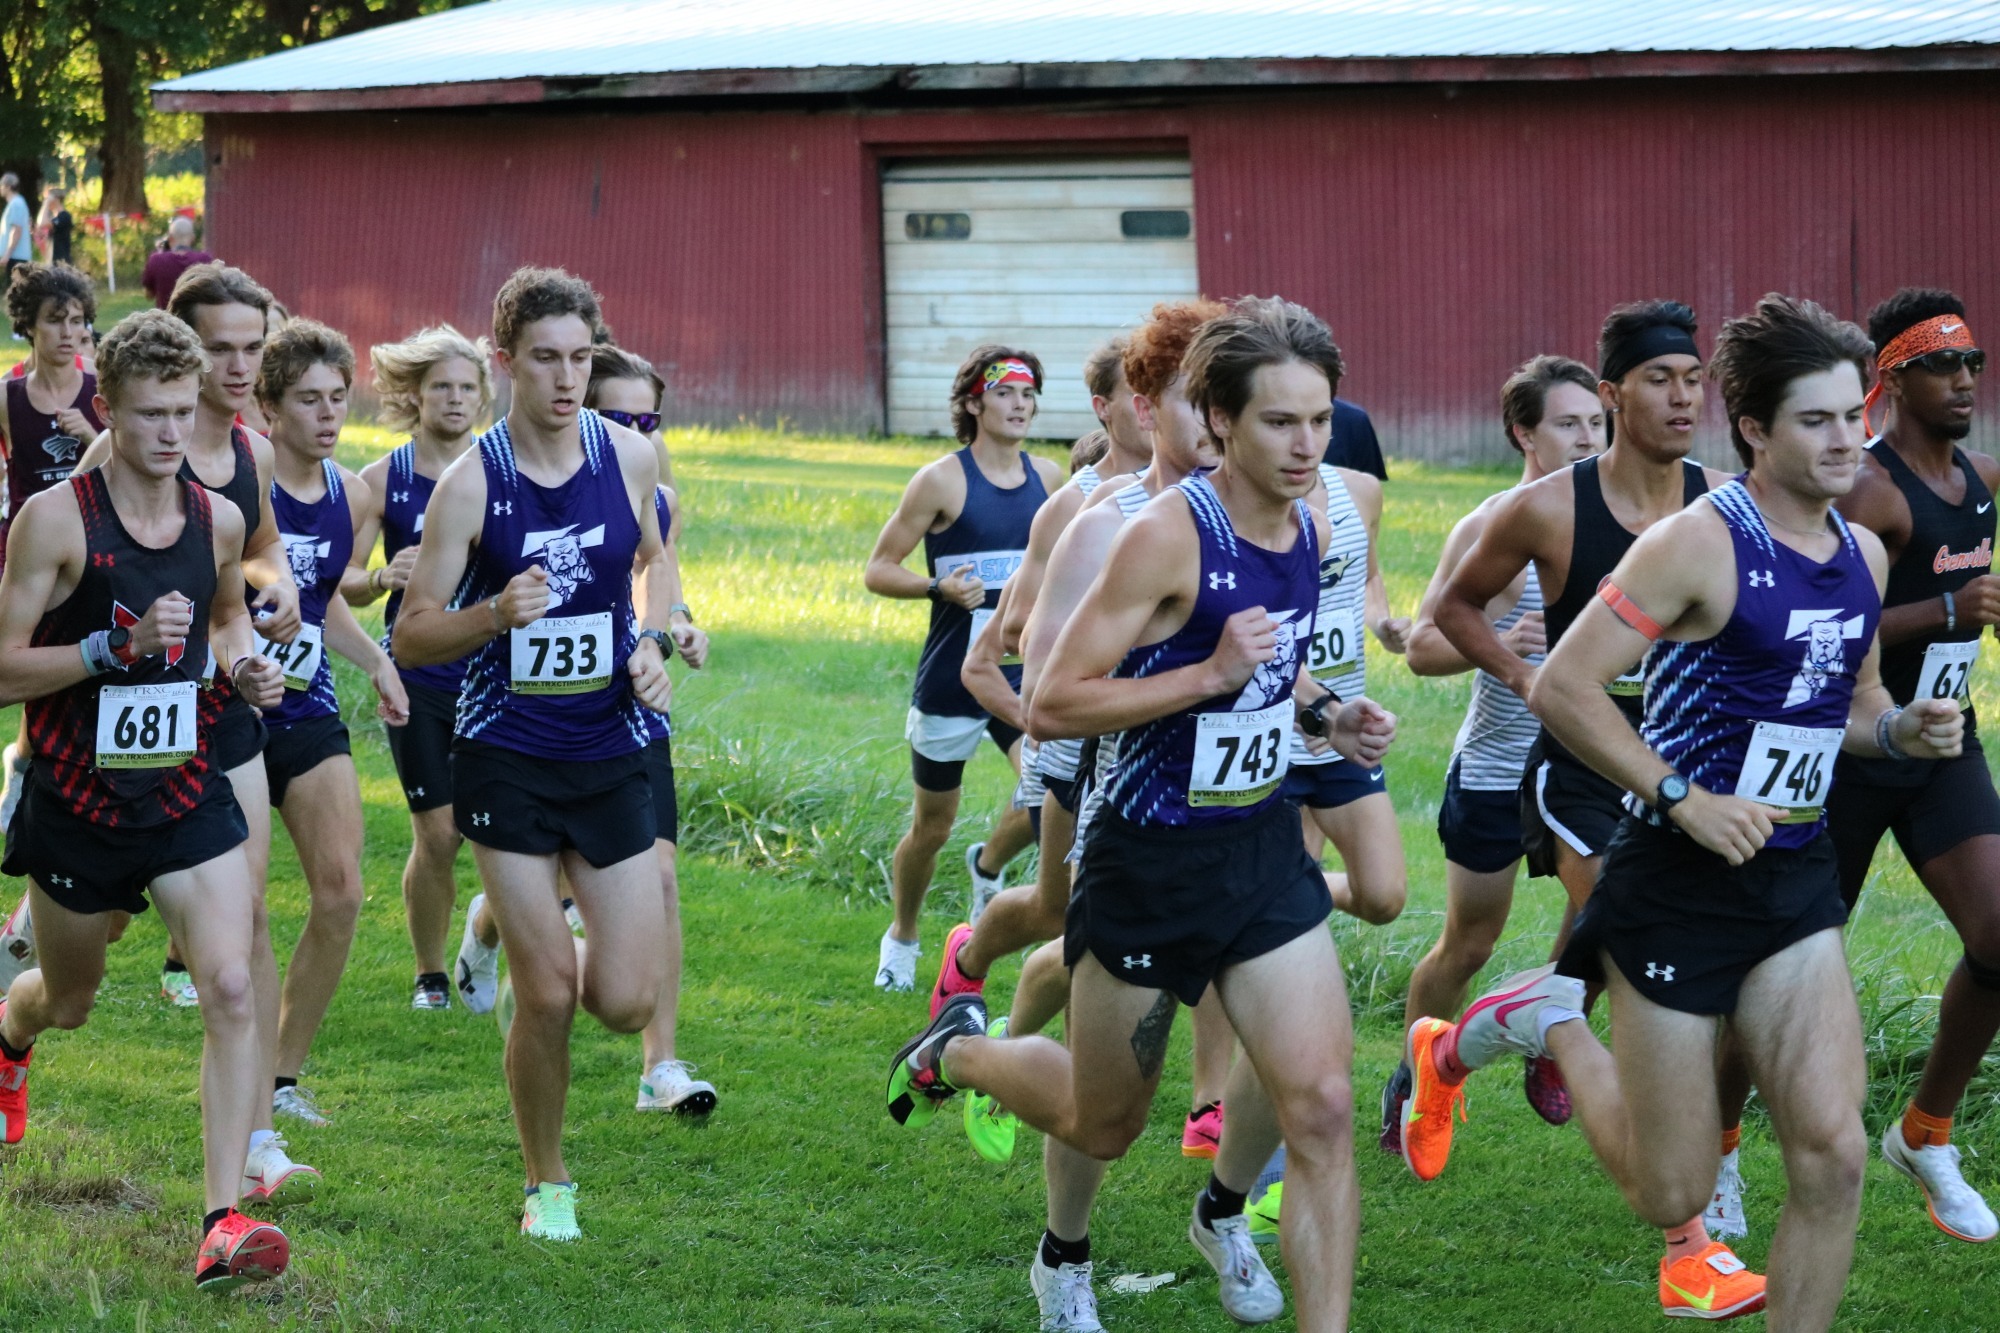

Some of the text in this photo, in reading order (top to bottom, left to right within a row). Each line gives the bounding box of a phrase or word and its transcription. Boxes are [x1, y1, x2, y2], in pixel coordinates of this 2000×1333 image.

[543, 618, 583, 627] TRXC
[528, 634, 597, 677] 733
[1303, 628, 1344, 666] 50
[131, 686, 171, 695] TRXC
[515, 676, 608, 688] WWW.TRXCTIMING.COM
[1932, 658, 1975, 699] 62
[114, 704, 179, 749] 681
[1232, 709, 1274, 723] TRXC
[100, 751, 193, 760] WWW.TRXCTIMING.COM
[1212, 727, 1281, 786] 743
[1757, 748, 1824, 802] 746
